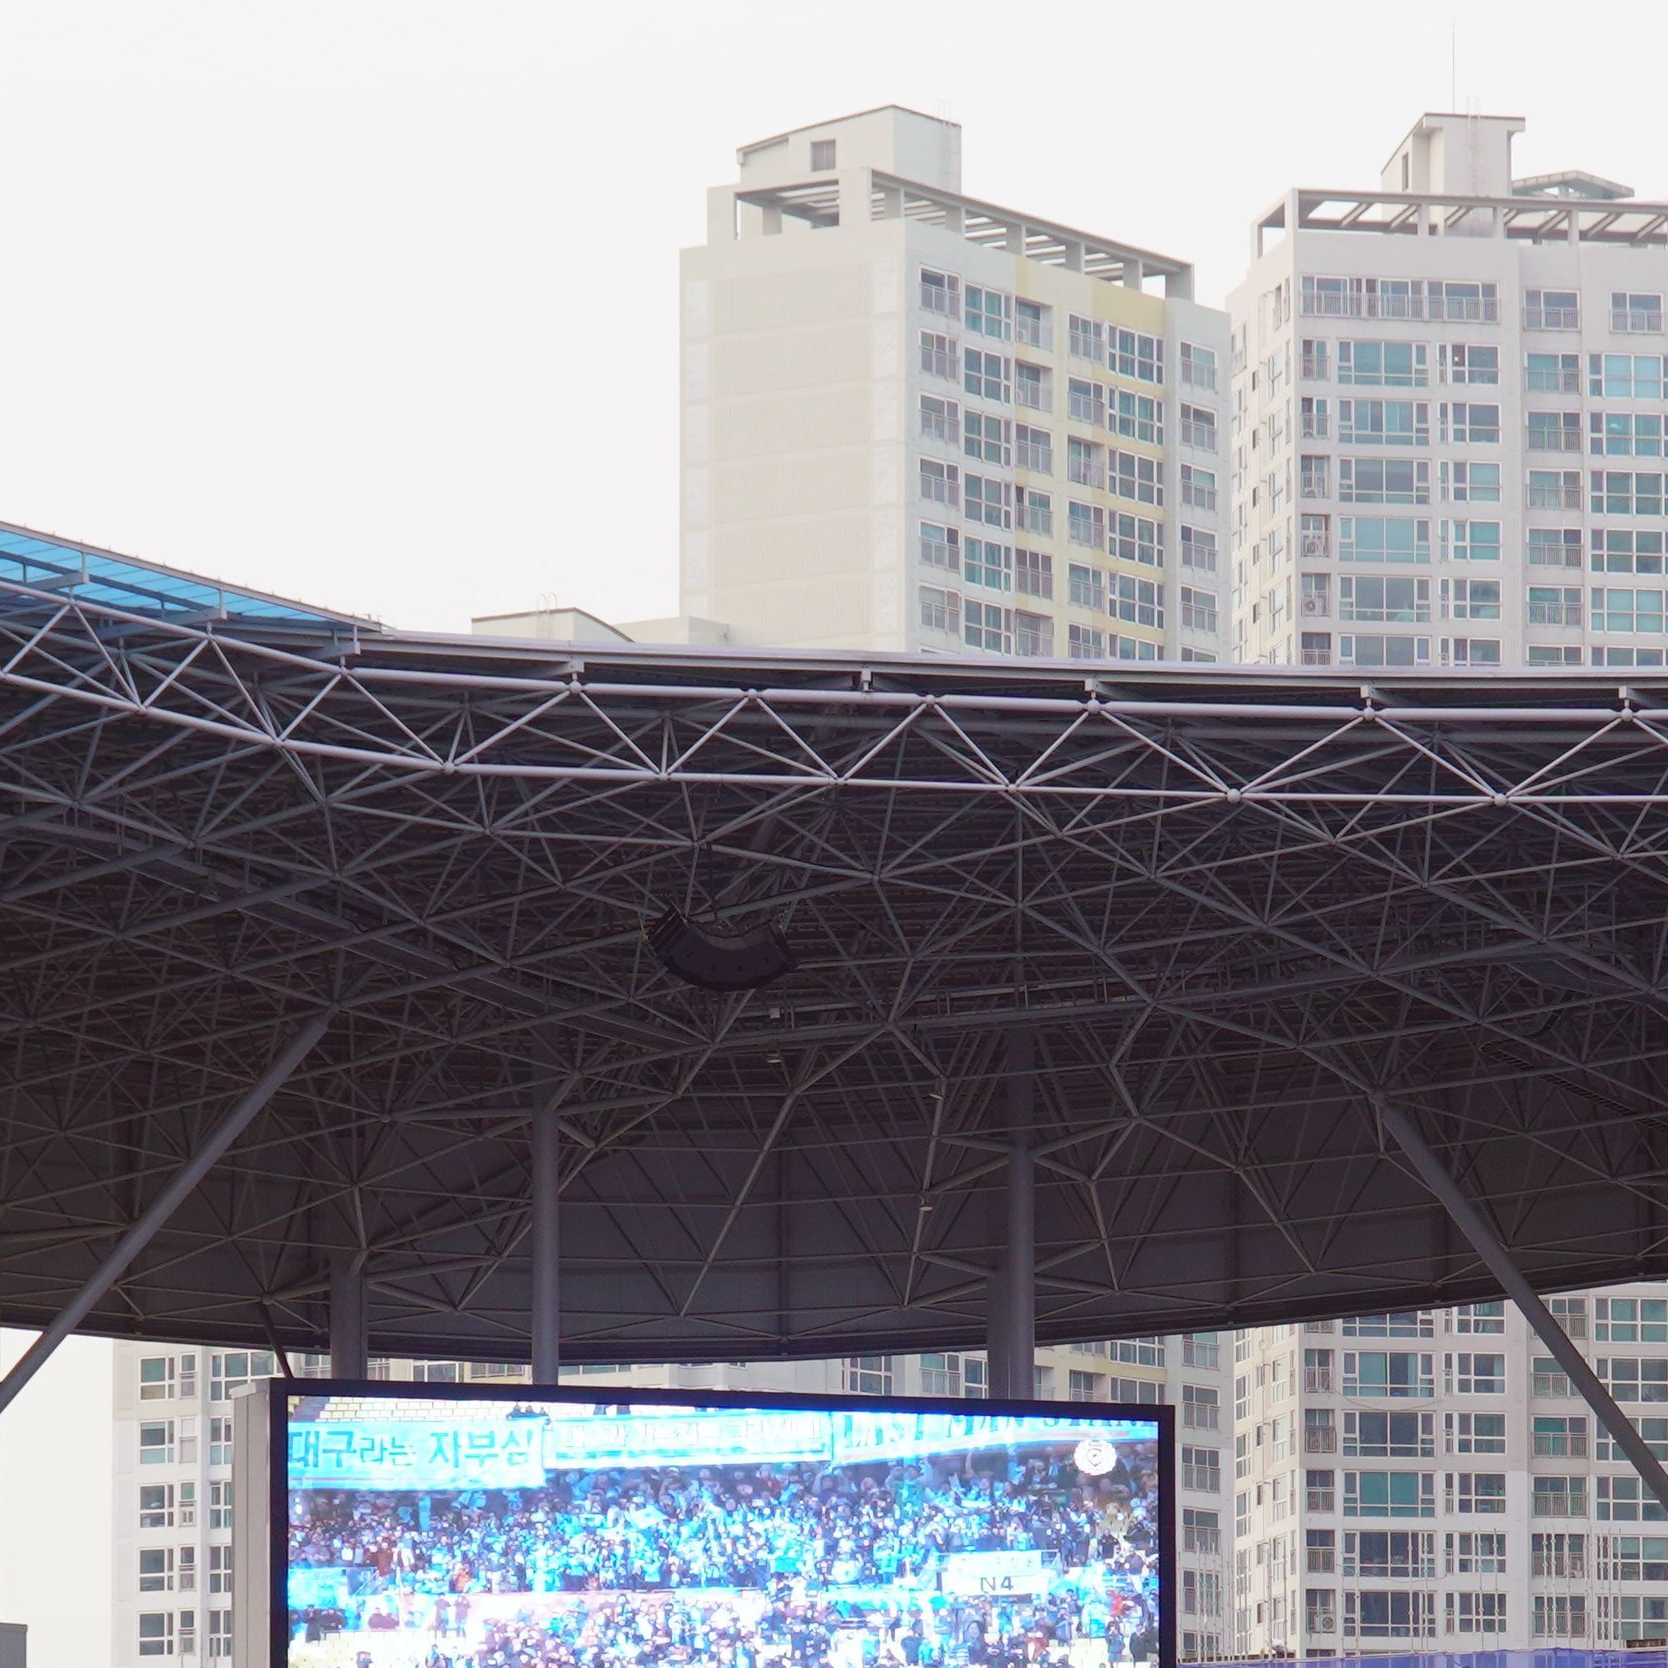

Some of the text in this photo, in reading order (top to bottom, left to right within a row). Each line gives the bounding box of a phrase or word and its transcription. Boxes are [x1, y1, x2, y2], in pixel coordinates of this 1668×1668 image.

[289, 1430, 416, 1469] 대구라는
[428, 1428, 534, 1469] 자부심
[980, 1575, 1014, 1592] N4
